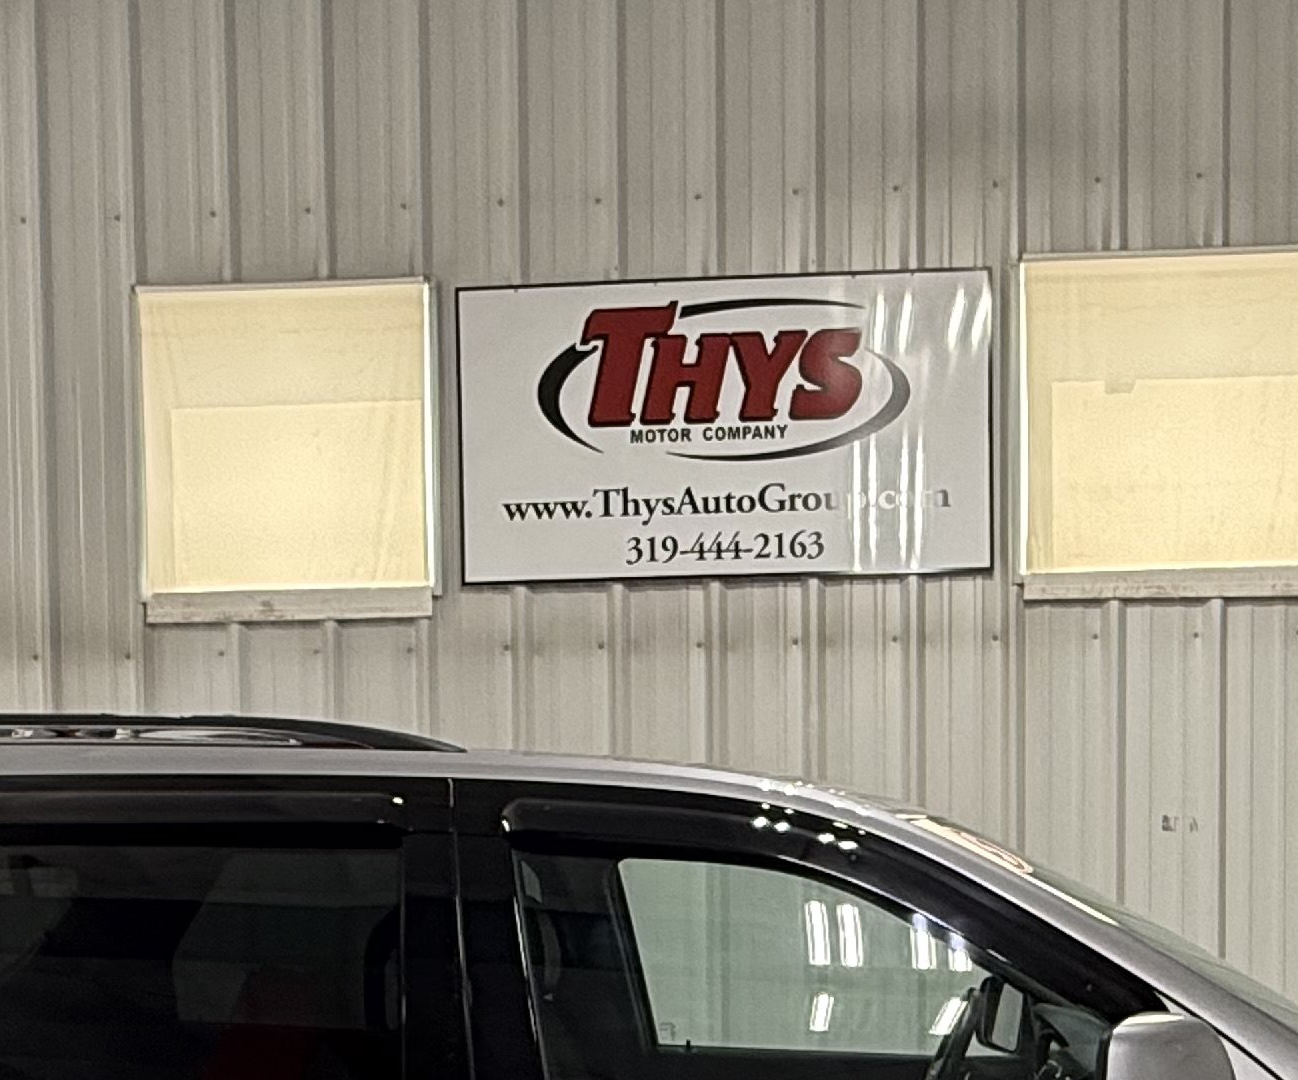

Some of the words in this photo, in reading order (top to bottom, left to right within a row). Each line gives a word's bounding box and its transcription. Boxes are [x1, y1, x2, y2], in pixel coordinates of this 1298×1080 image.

[581, 300, 862, 427] THYS
[629, 428, 692, 444] MOTOR
[702, 424, 788, 441] COMPANY
[502, 483, 951, 526] www.ThysAutoGroupcom
[626, 530, 825, 565] 319-444-2163
